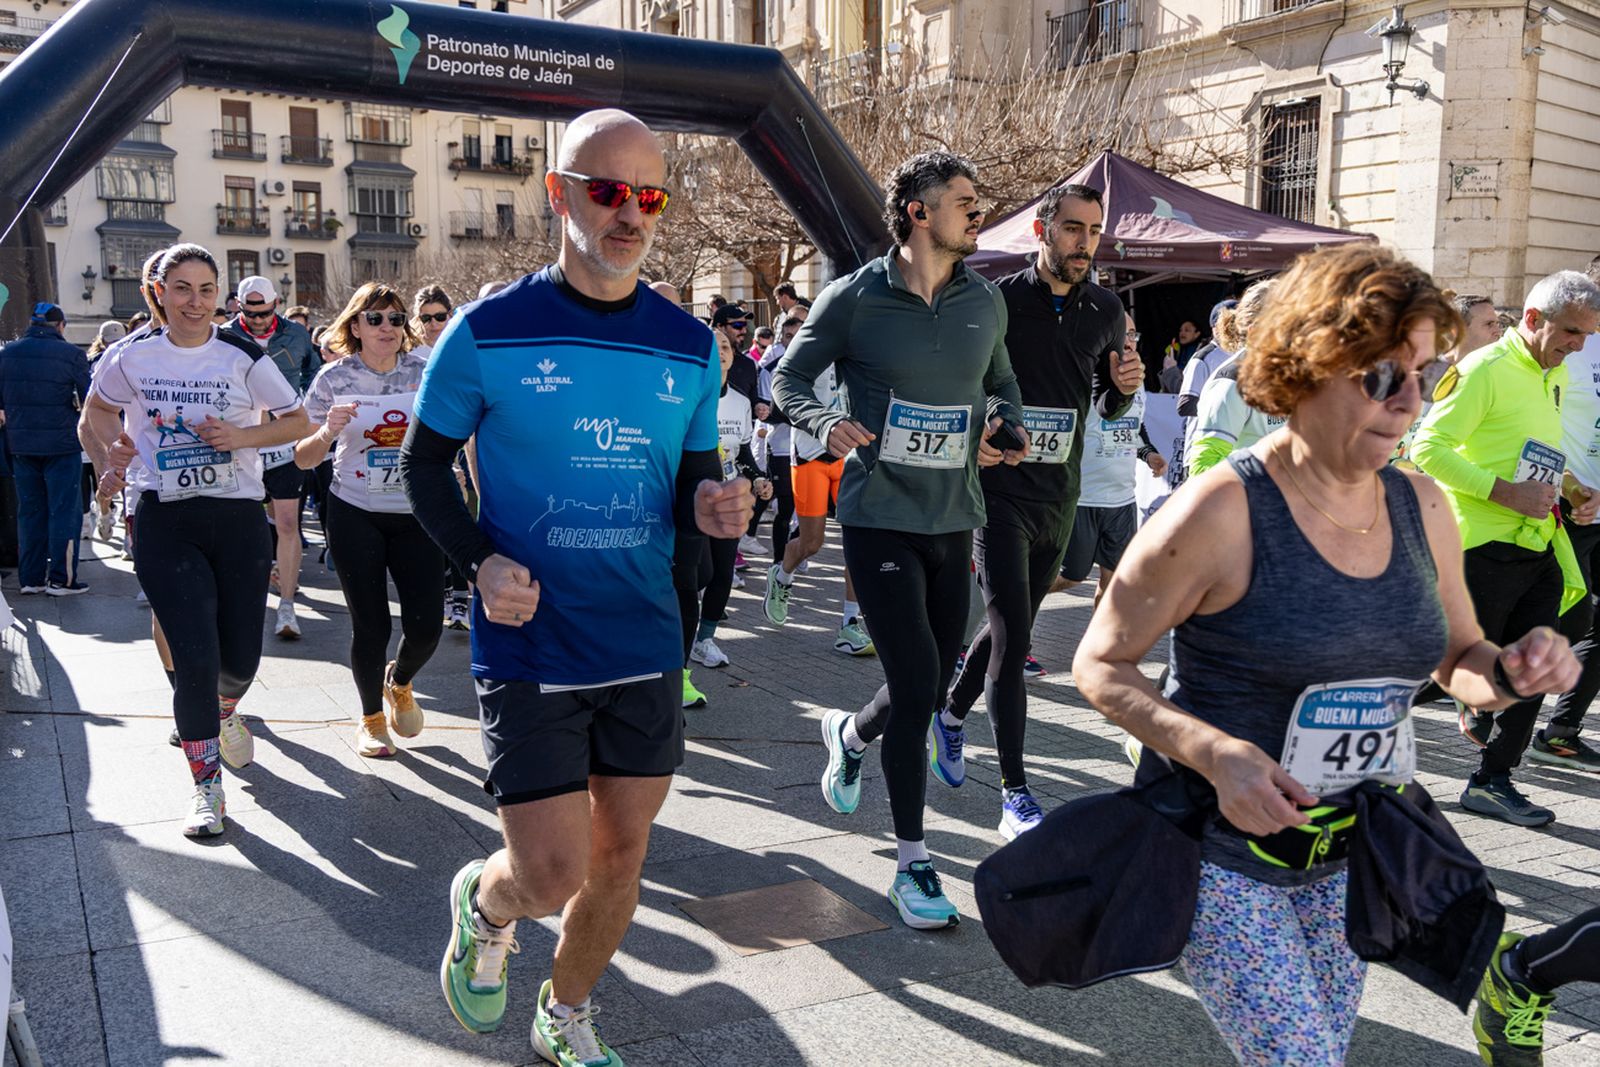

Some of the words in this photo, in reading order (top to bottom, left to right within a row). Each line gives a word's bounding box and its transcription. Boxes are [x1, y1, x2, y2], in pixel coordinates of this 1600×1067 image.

[427, 33, 509, 59] Patronato
[514, 44, 590, 69] Municipal
[595, 54, 615, 71] de
[427, 54, 504, 79] Deportes
[509, 64, 530, 81] de
[534, 67, 573, 86] Jaén
[140, 378, 148, 386] VI
[149, 379, 187, 388] CARRERA
[188, 381, 230, 390] CAMINATA
[521, 376, 541, 385] CAJA
[543, 376, 573, 385] RURAL
[536, 385, 557, 393] JAÉN
[171, 391, 212, 405] MUERTE
[907, 408, 935, 419] CARRERA
[897, 416, 921, 429] BUENA
[922, 420, 949, 432] MUERTE
[1036, 420, 1059, 431] MUERTE
[618, 427, 642, 435] MEDIA
[615, 435, 651, 445] MARATÓN
[906, 431, 950, 455] 517
[612, 443, 631, 451] JAÉN
[177, 465, 217, 488] 610
[1321, 691, 1331, 702] VI
[1332, 690, 1382, 703] CARRERA
[1314, 706, 1357, 725] BUENA
[1322, 728, 1398, 771] 497
